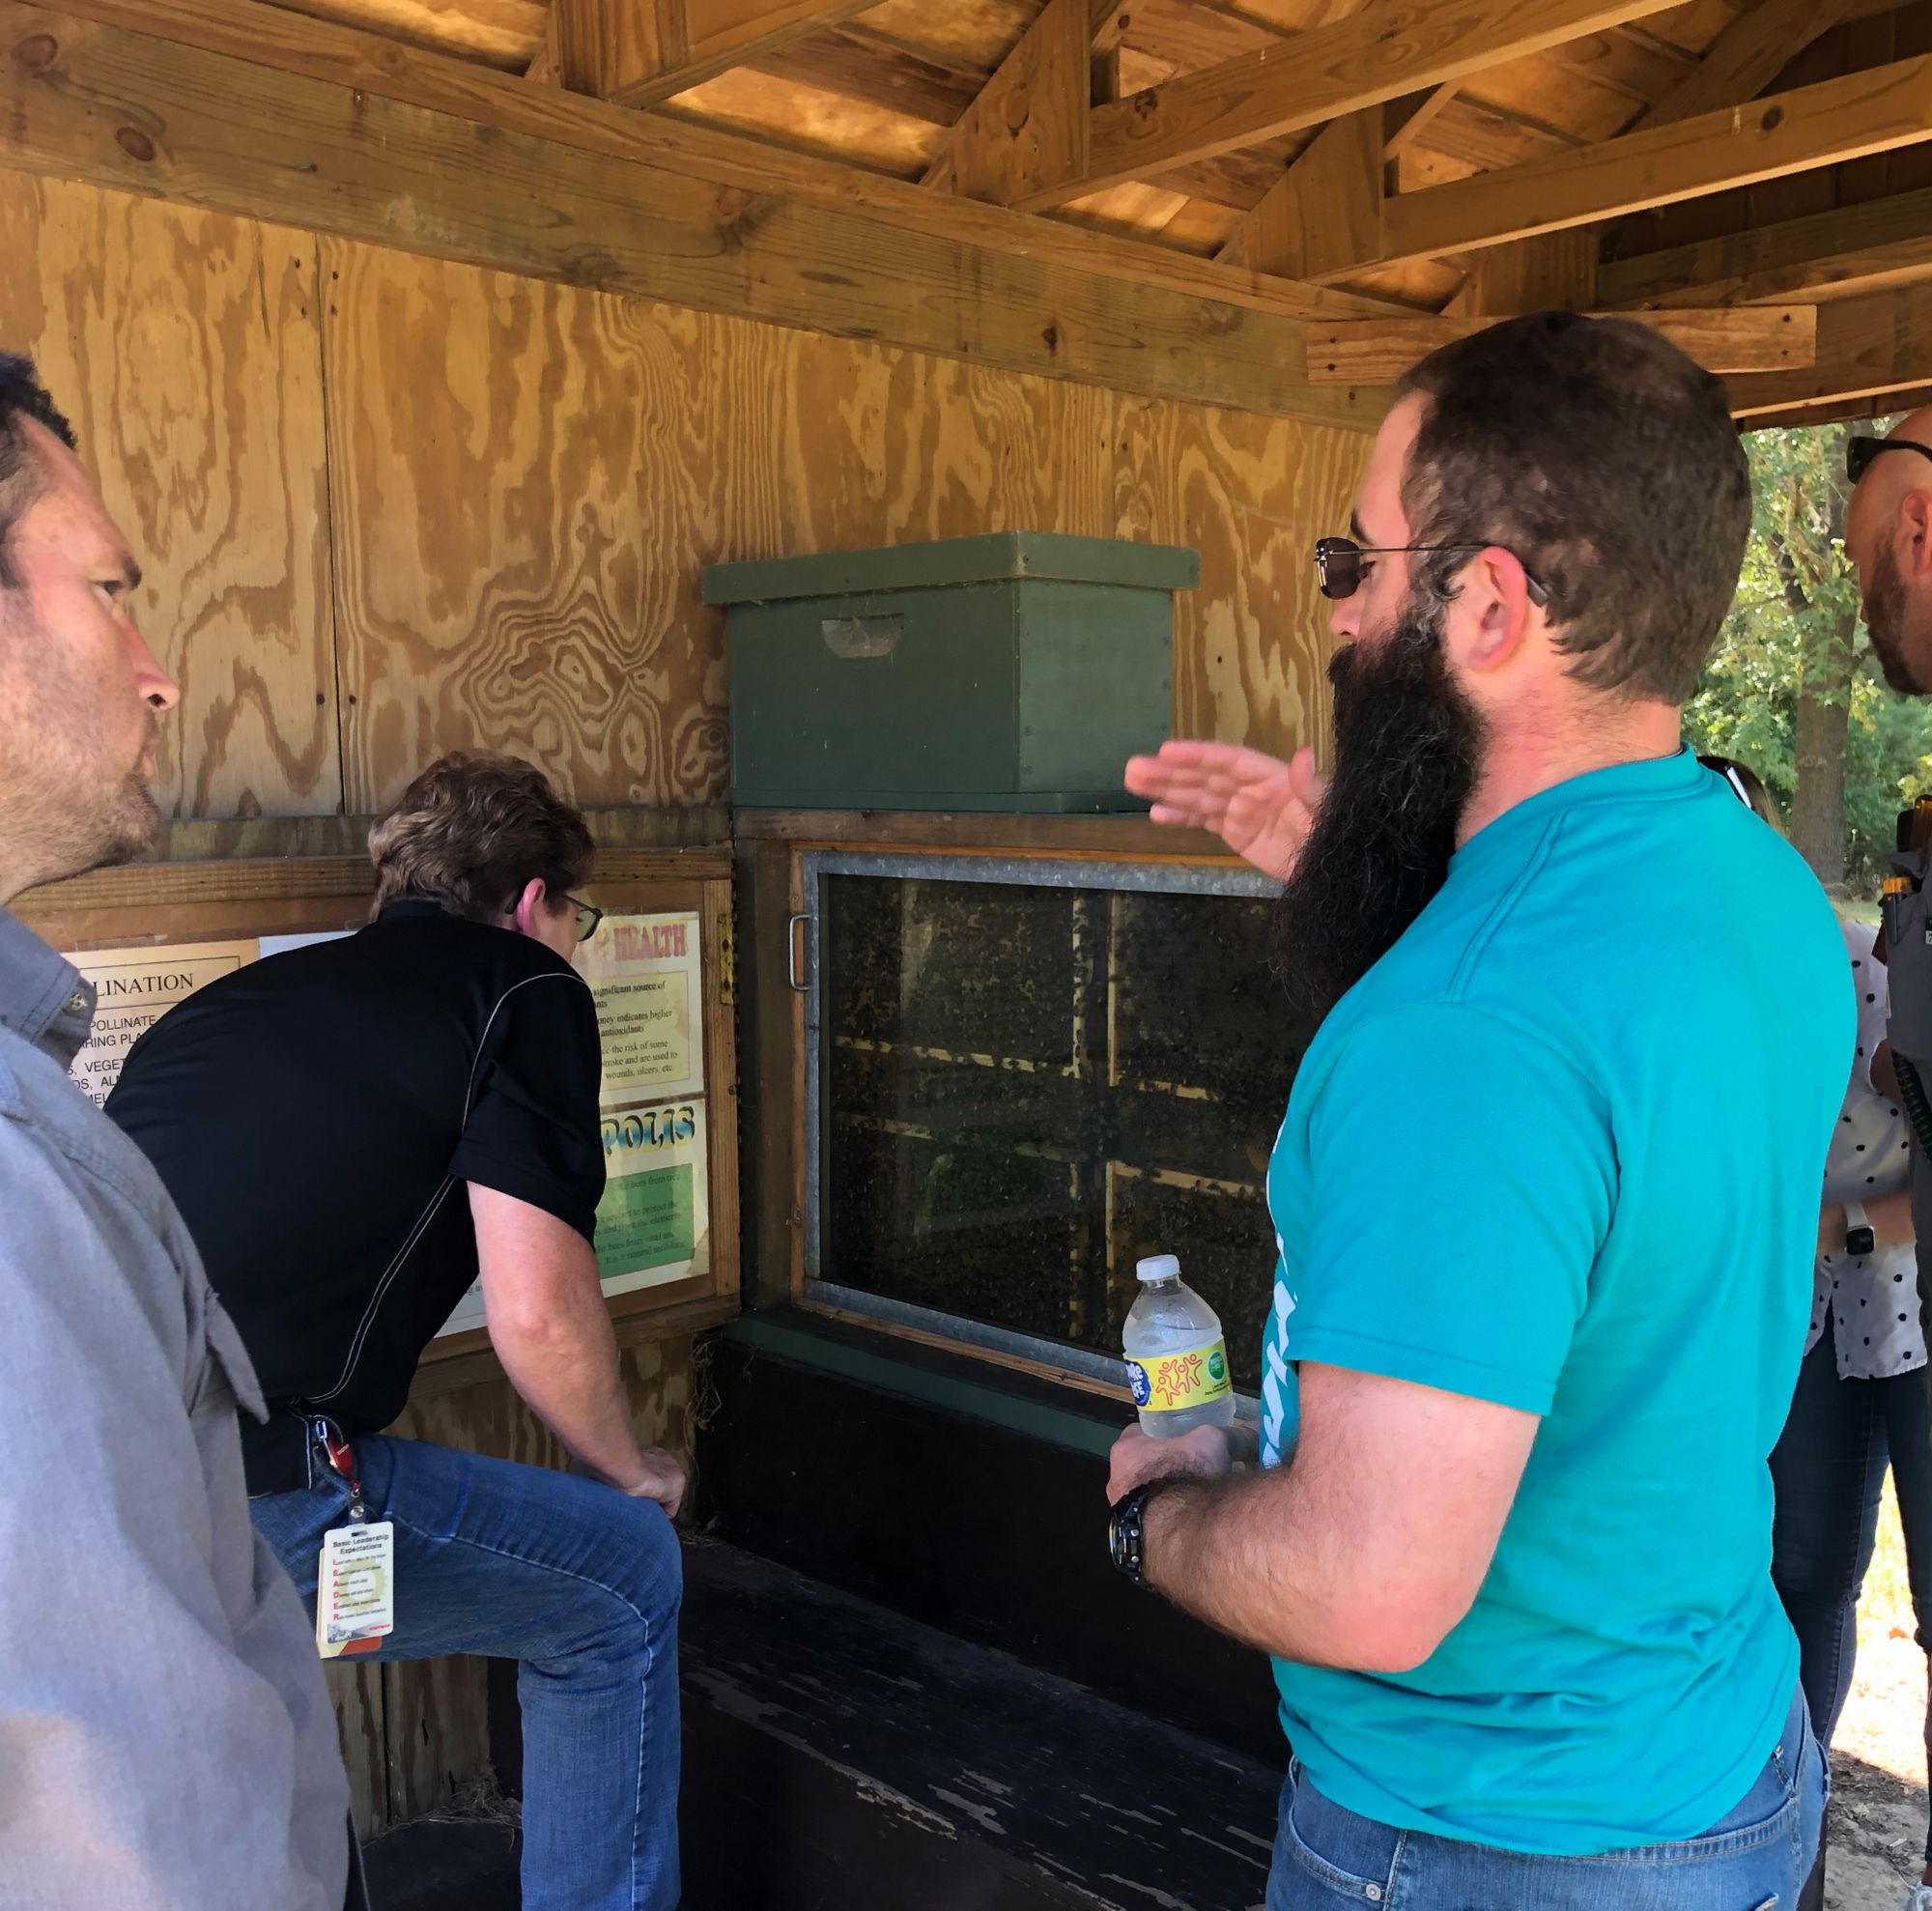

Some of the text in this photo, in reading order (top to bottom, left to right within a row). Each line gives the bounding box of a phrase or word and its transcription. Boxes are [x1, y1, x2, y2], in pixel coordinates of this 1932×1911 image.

[613, 923, 687, 960] HEALTH
[633, 984, 657, 993] source
[657, 980, 667, 990] of
[649, 1009, 672, 1020] higher
[82, 1034, 116, 1049] RING
[611, 1044, 624, 1054] the
[624, 1041, 639, 1052] risk
[639, 1041, 649, 1050] of
[649, 1041, 668, 1049] some
[625, 1055, 639, 1065] and
[639, 1054, 651, 1063] are
[652, 1051, 669, 1061] used
[340, 1543, 383, 1554] Expectations
